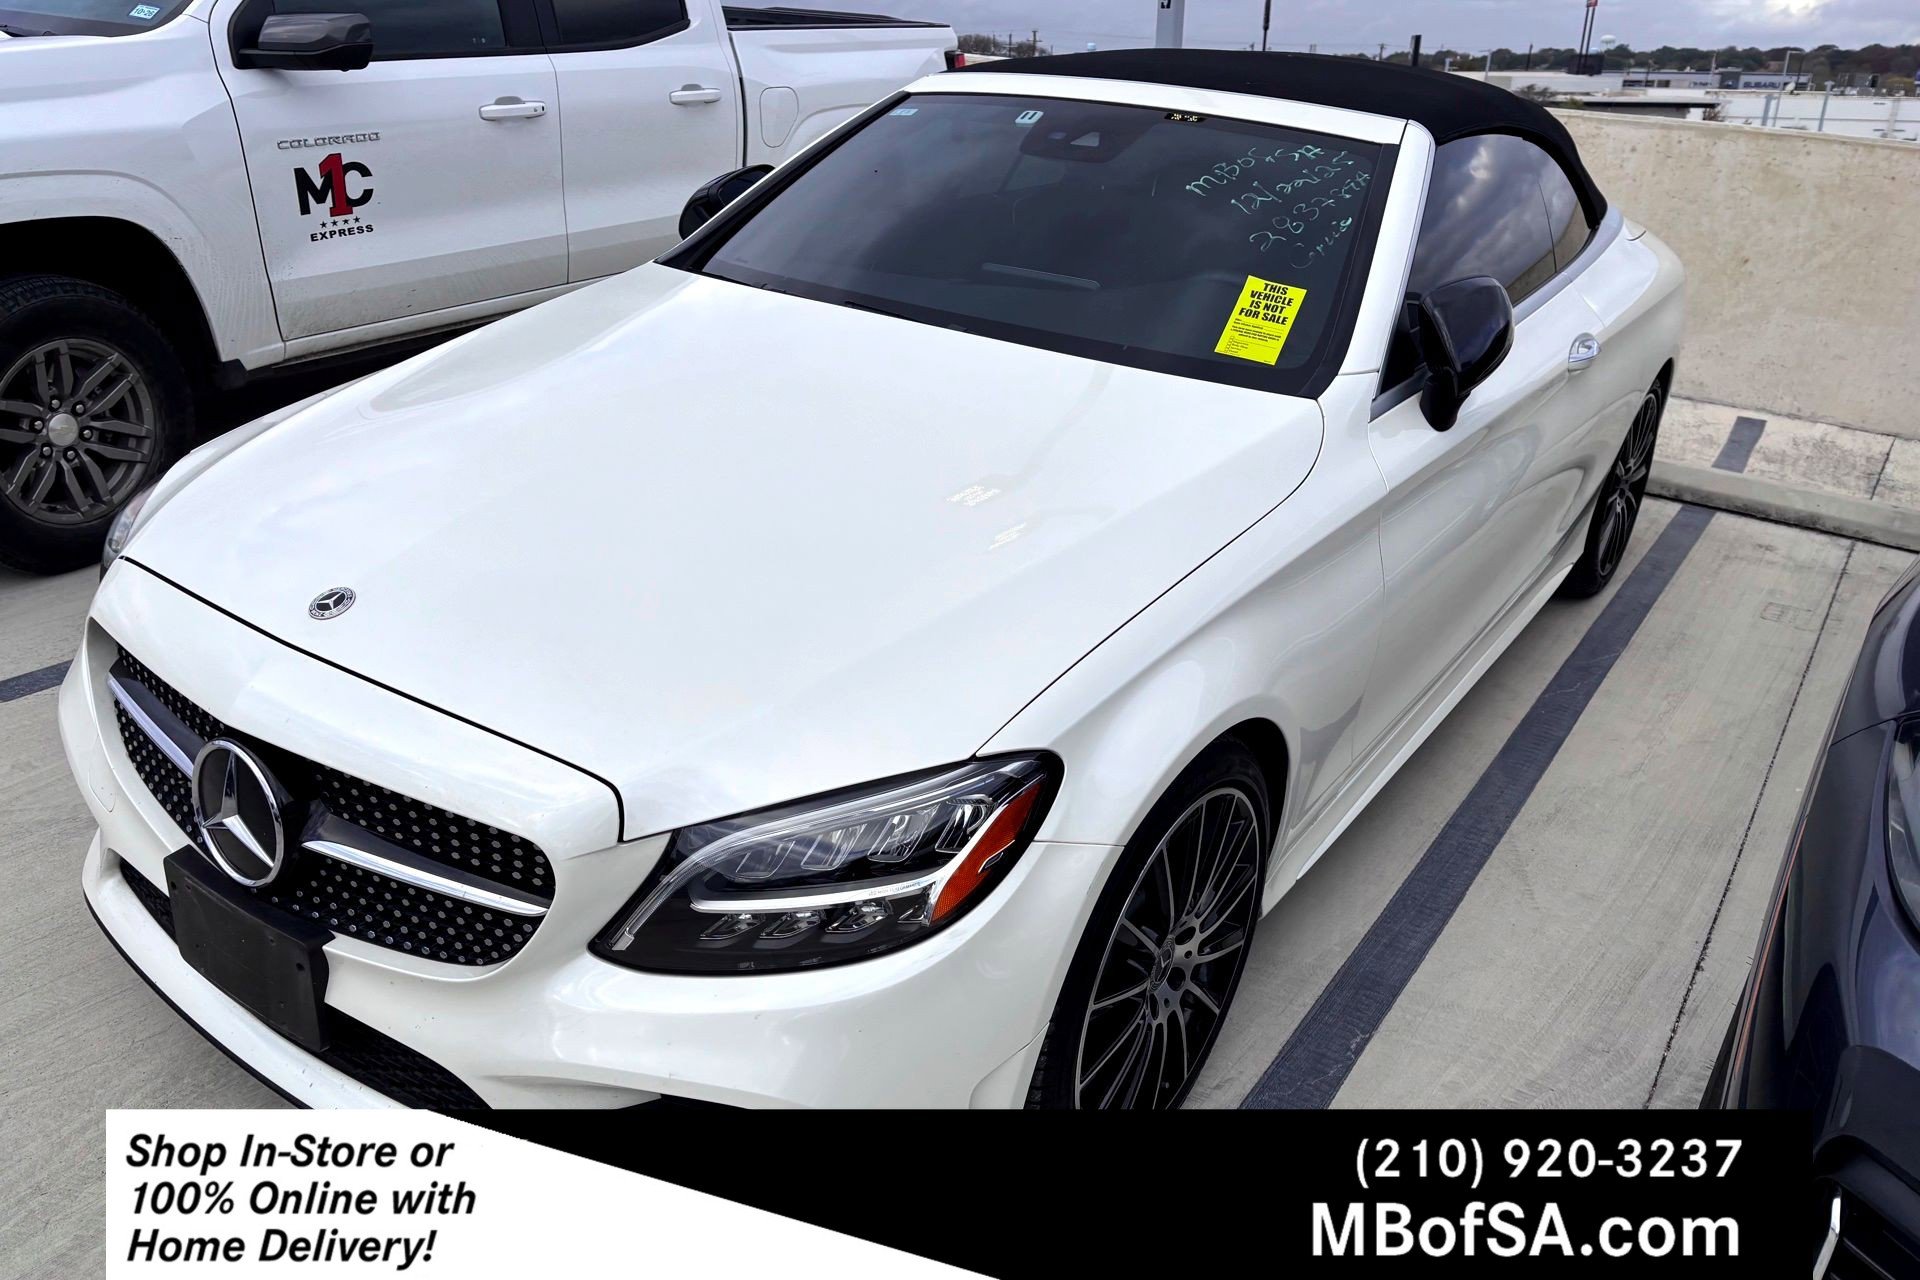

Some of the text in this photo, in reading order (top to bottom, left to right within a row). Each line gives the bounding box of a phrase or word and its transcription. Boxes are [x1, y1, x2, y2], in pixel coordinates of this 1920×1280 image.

[277, 132, 380, 150] COLORADO
[310, 224, 374, 242] EXPRESS
[1263, 283, 1289, 296] THIS
[1249, 299, 1287, 315] IS NOT
[1250, 290, 1294, 307] VEHICLE
[1238, 307, 1261, 319] FOR
[1261, 312, 1289, 326] SALE
